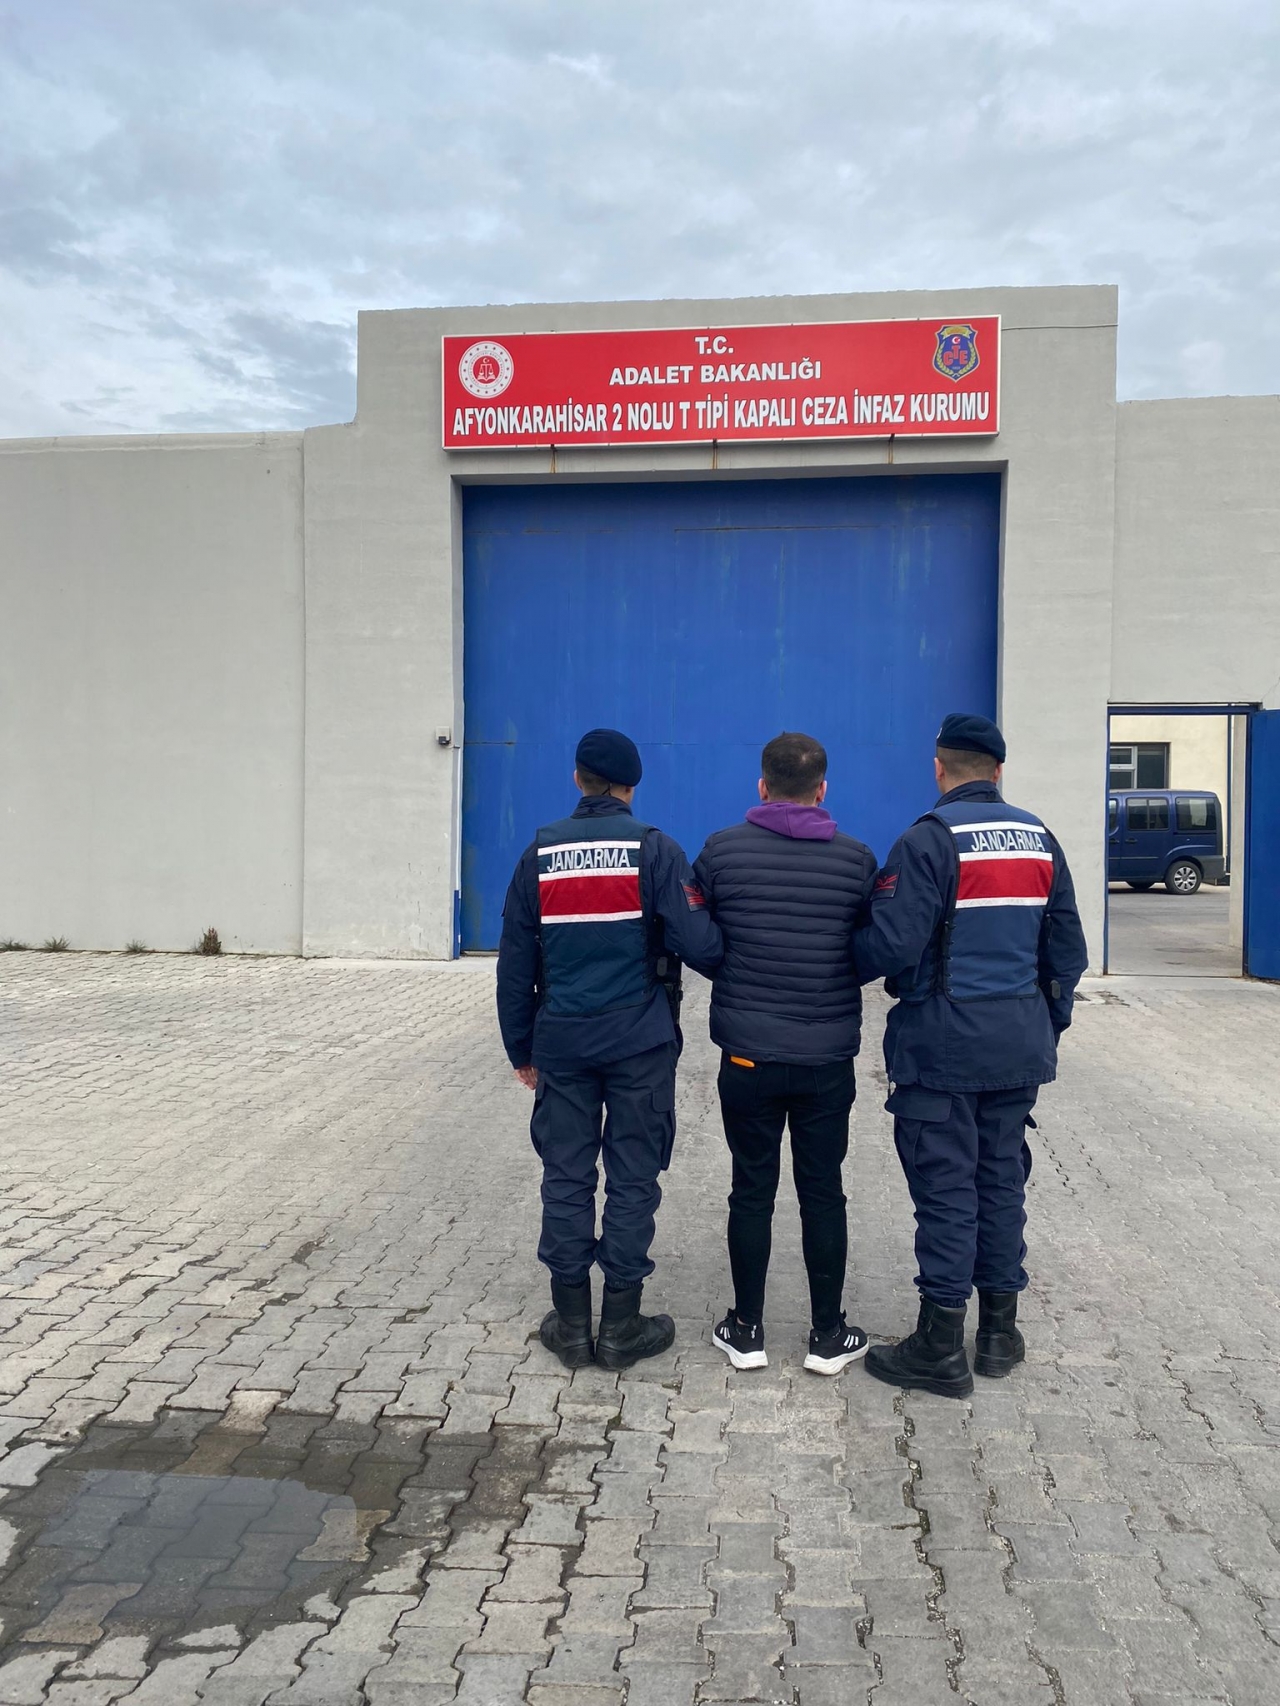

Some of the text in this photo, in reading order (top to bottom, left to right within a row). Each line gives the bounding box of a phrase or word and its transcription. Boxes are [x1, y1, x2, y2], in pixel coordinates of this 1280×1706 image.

[694, 335, 734, 355] T.C.
[609, 357, 821, 386] ADALET BAKANLIĞI
[452, 389, 990, 436] AFYONKARAHİSAR 2 NOLU T TİPİ KAPALI CEZA İNFAZ KURUMU
[971, 830, 1046, 852] JANDARMA
[546, 848, 631, 873] JANDARMA
